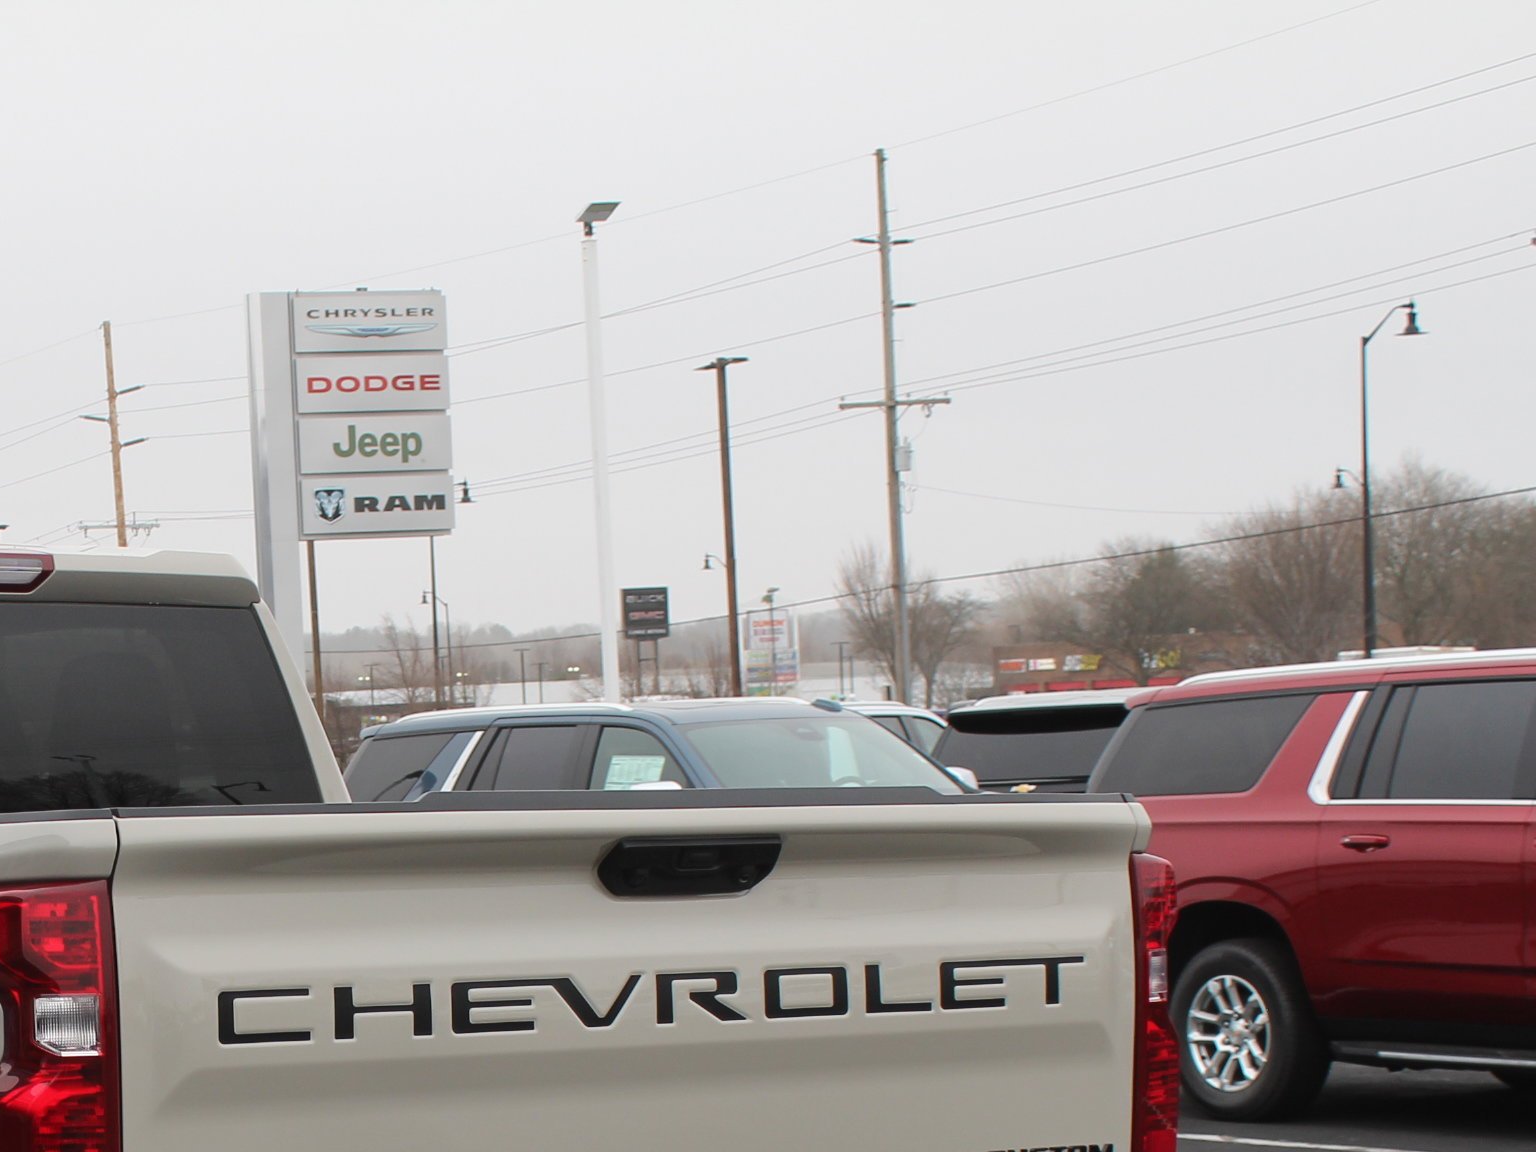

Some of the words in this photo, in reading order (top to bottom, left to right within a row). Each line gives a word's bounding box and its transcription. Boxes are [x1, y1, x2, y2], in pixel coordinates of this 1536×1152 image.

[306, 307, 435, 319] CHRYSLER
[307, 374, 441, 394] DODGE
[332, 424, 423, 463] Jeep
[353, 494, 446, 513] RAM
[218, 955, 1085, 1045] CHEVROLET
